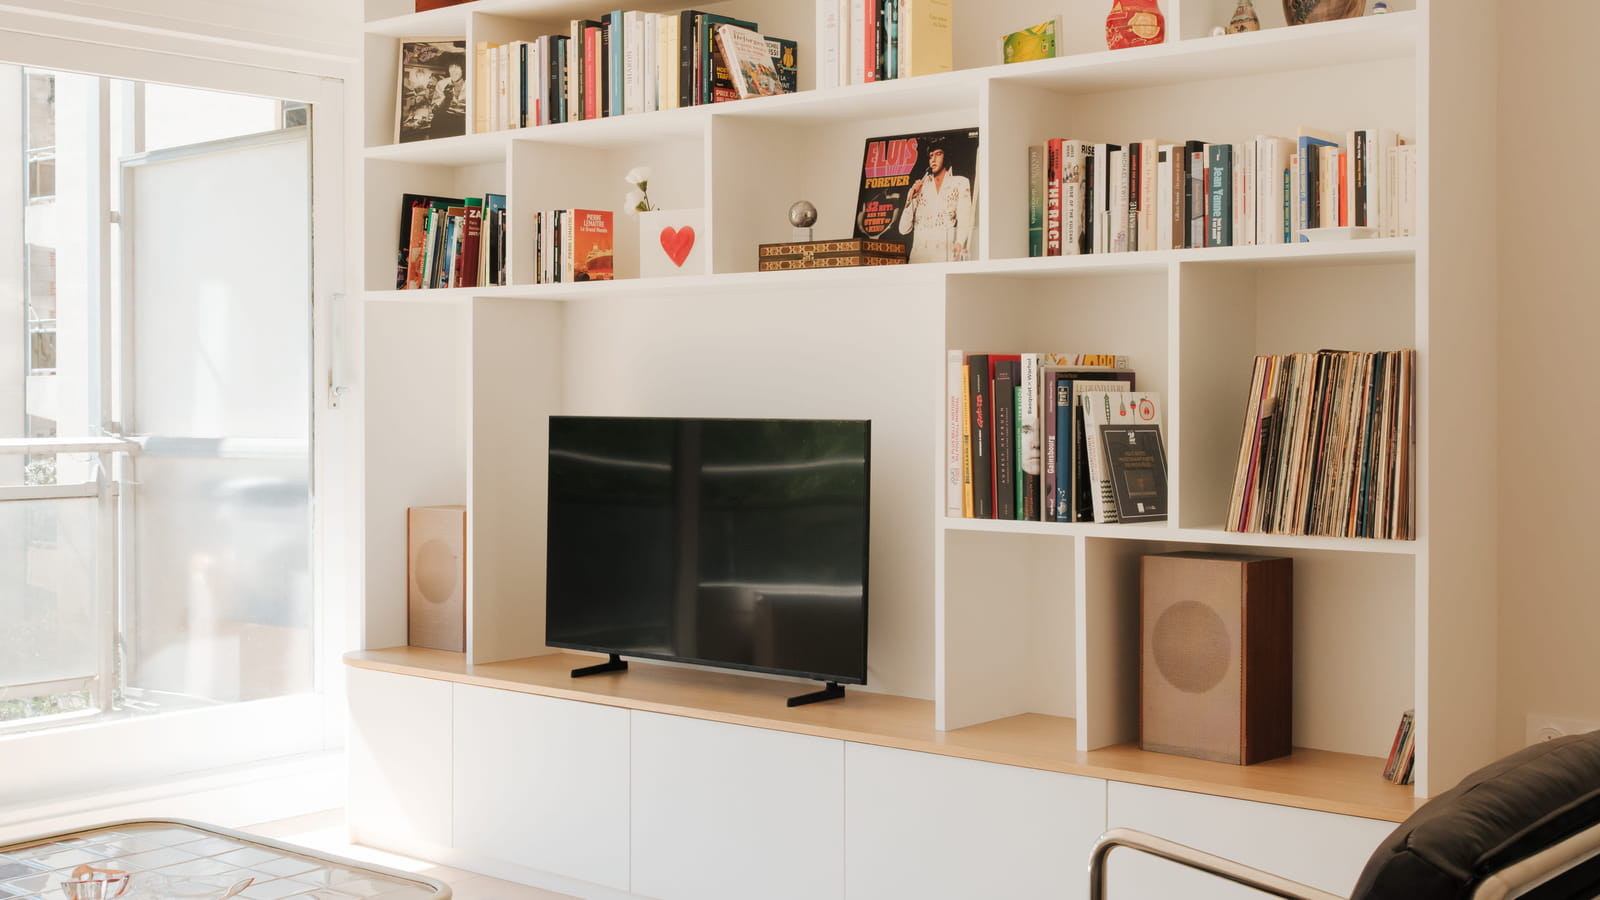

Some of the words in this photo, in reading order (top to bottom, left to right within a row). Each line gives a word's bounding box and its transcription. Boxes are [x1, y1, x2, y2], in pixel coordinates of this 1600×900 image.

[865, 138, 918, 173] ELVIS
[865, 175, 910, 189] FOREVER
[1213, 167, 1224, 187] Jean
[1048, 178, 1059, 208] THE
[1213, 188, 1224, 217] Yanne
[1048, 209, 1059, 249] RACE
[1047, 435, 1056, 474] Gainsbourg
